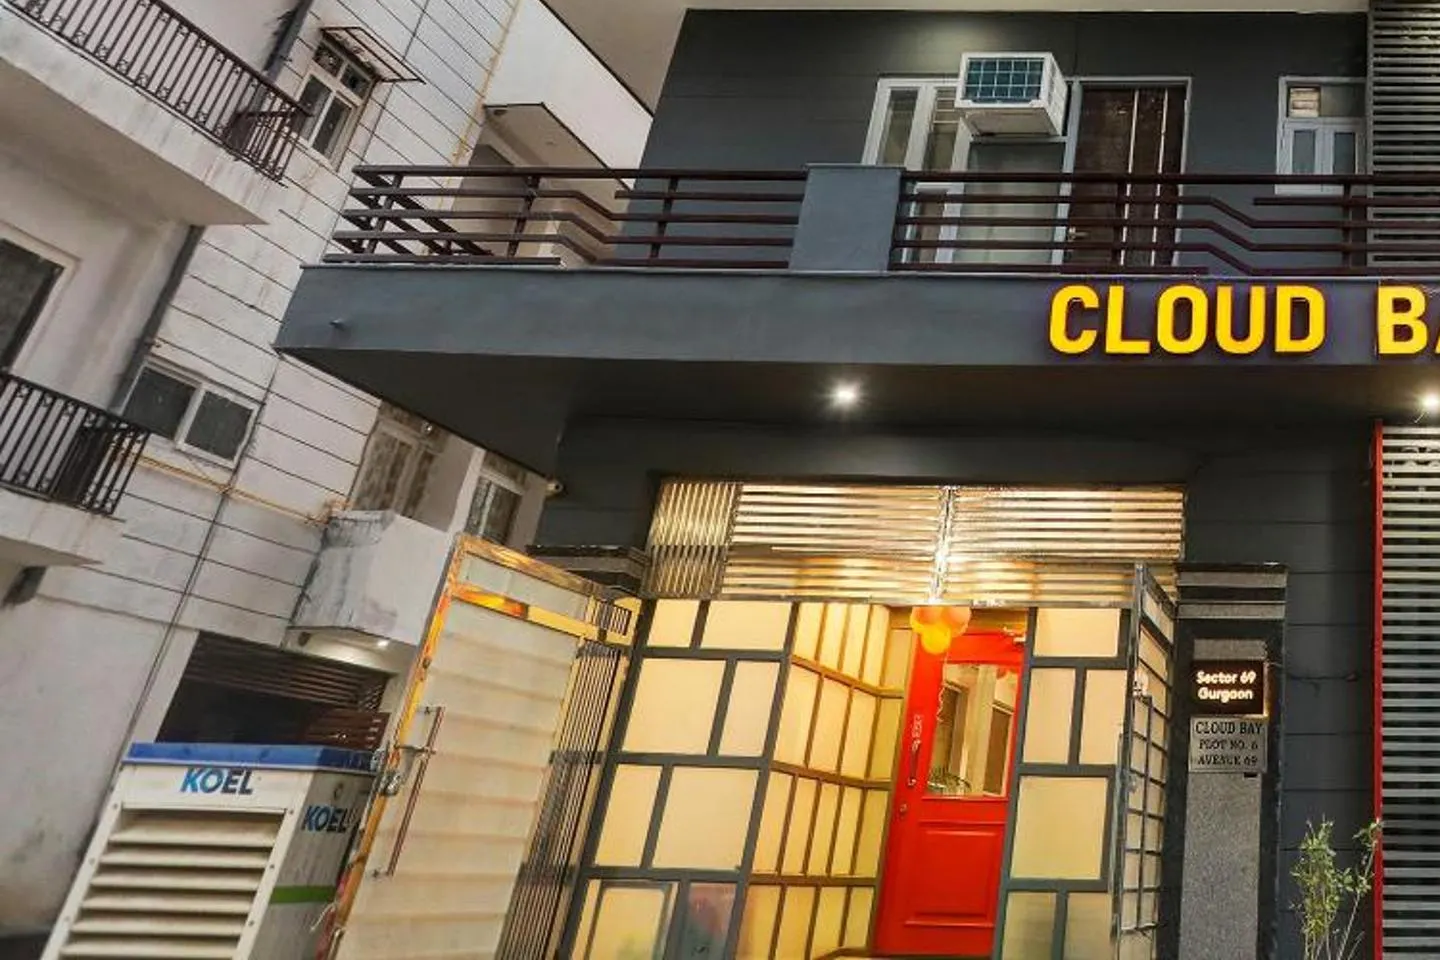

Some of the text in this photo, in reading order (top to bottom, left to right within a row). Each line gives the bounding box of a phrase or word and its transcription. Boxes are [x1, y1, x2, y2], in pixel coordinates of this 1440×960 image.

[1049, 284, 1326, 355] CLOUD
[1196, 670, 1256, 684] Sector 69
[1195, 721, 1263, 735] CLOUD BAY
[1199, 739, 1226, 750] PLOT
[180, 768, 254, 795] KOEL
[302, 805, 349, 833] KOEL
